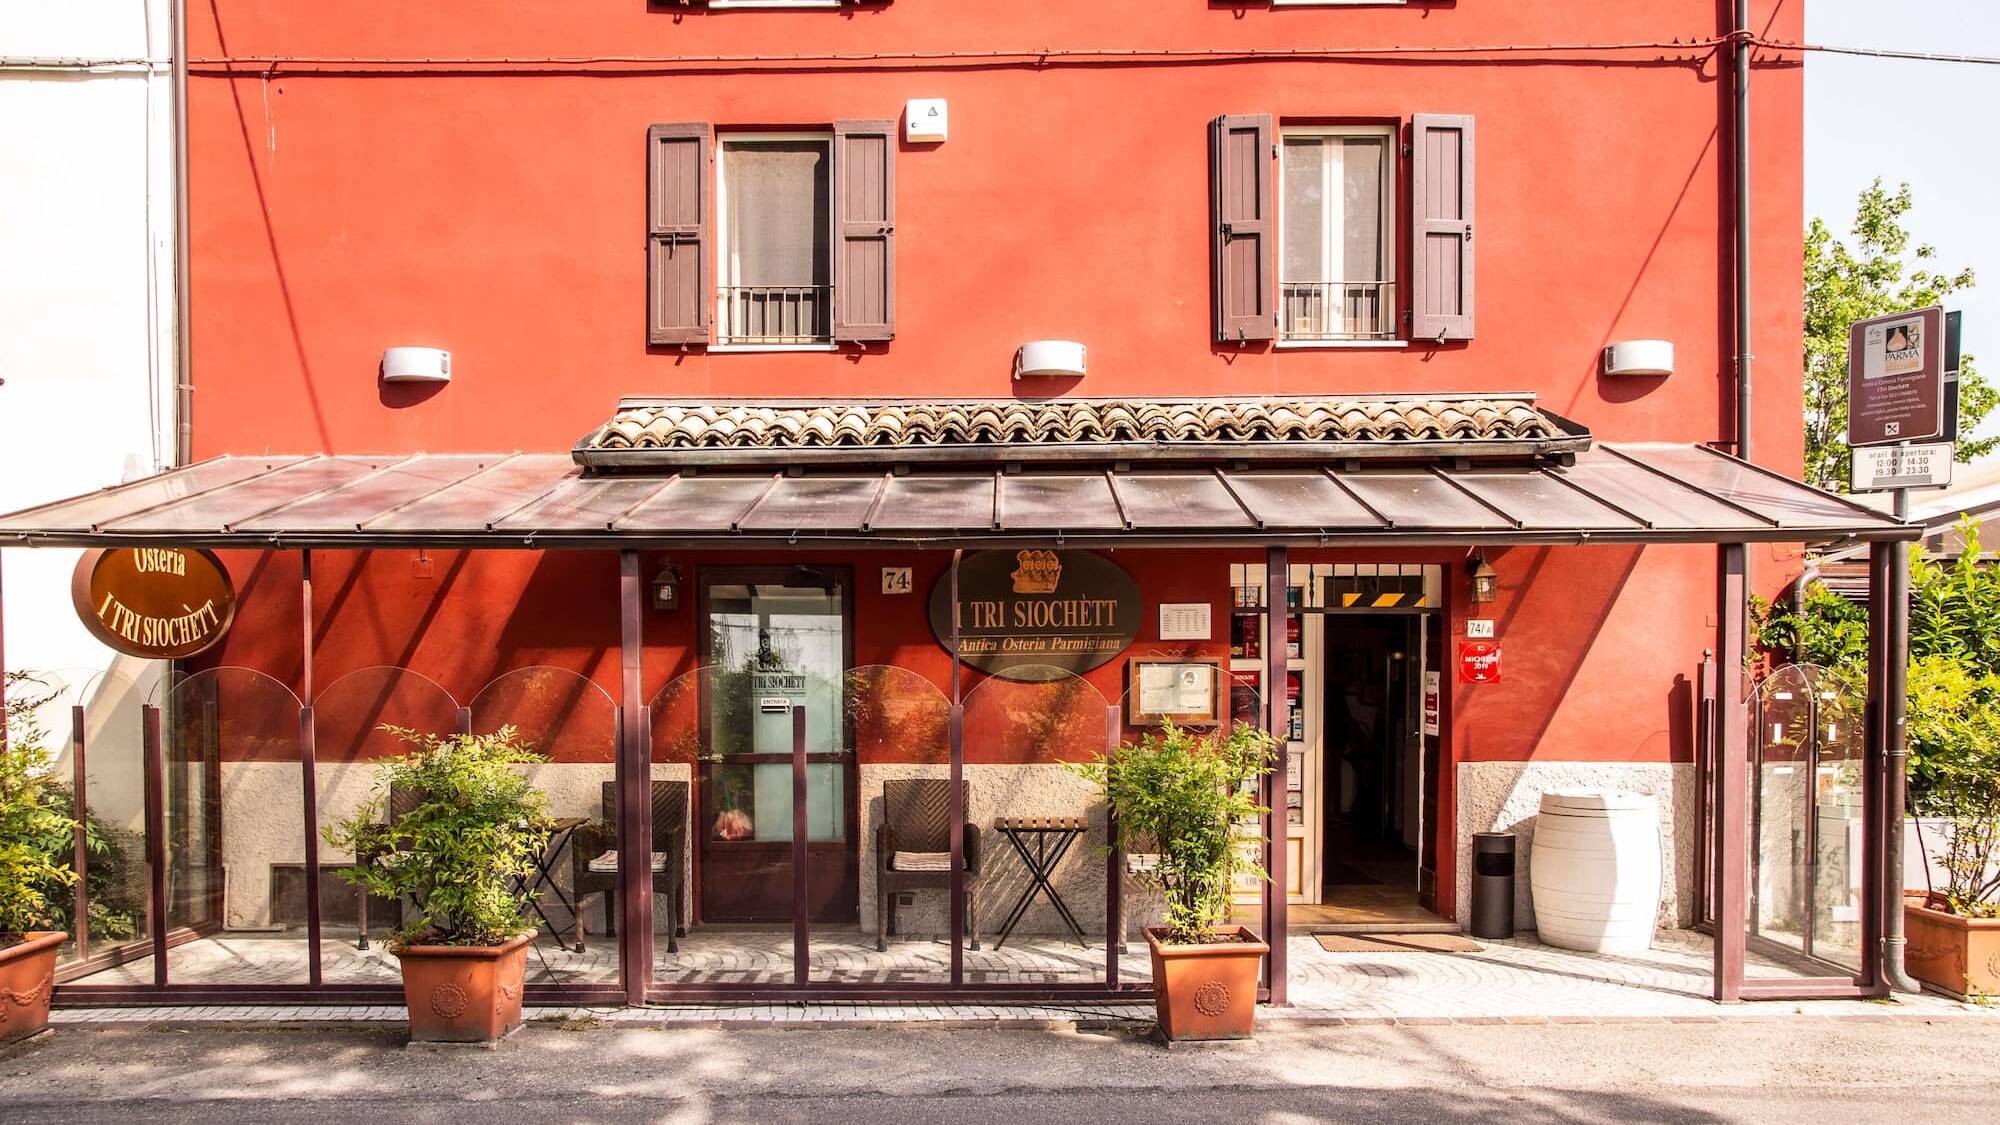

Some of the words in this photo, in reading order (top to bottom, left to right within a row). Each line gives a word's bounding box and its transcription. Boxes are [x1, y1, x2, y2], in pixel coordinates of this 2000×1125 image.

[1885, 349, 1920, 361] PARMA
[1868, 450, 1888, 459] orari
[1891, 450, 1897, 458] di
[1900, 448, 1937, 458] apertura:
[1907, 457, 1929, 465] 14:30
[1875, 468, 1897, 476] 19:30
[1906, 466, 1929, 474] 23:30
[134, 547, 186, 577] Osteria
[884, 571, 910, 589] 74
[957, 601, 963, 628] I
[970, 601, 1006, 628] TRI
[1014, 593, 1118, 629] SIOCHÈTT
[97, 591, 114, 620] I
[110, 600, 142, 643] TRI
[142, 599, 220, 647] SIOCHÈTT
[1470, 622, 1492, 635] 74/A
[958, 638, 998, 651] Antica
[1002, 637, 1046, 651] Osteria
[1051, 636, 1121, 651] Parmigiana
